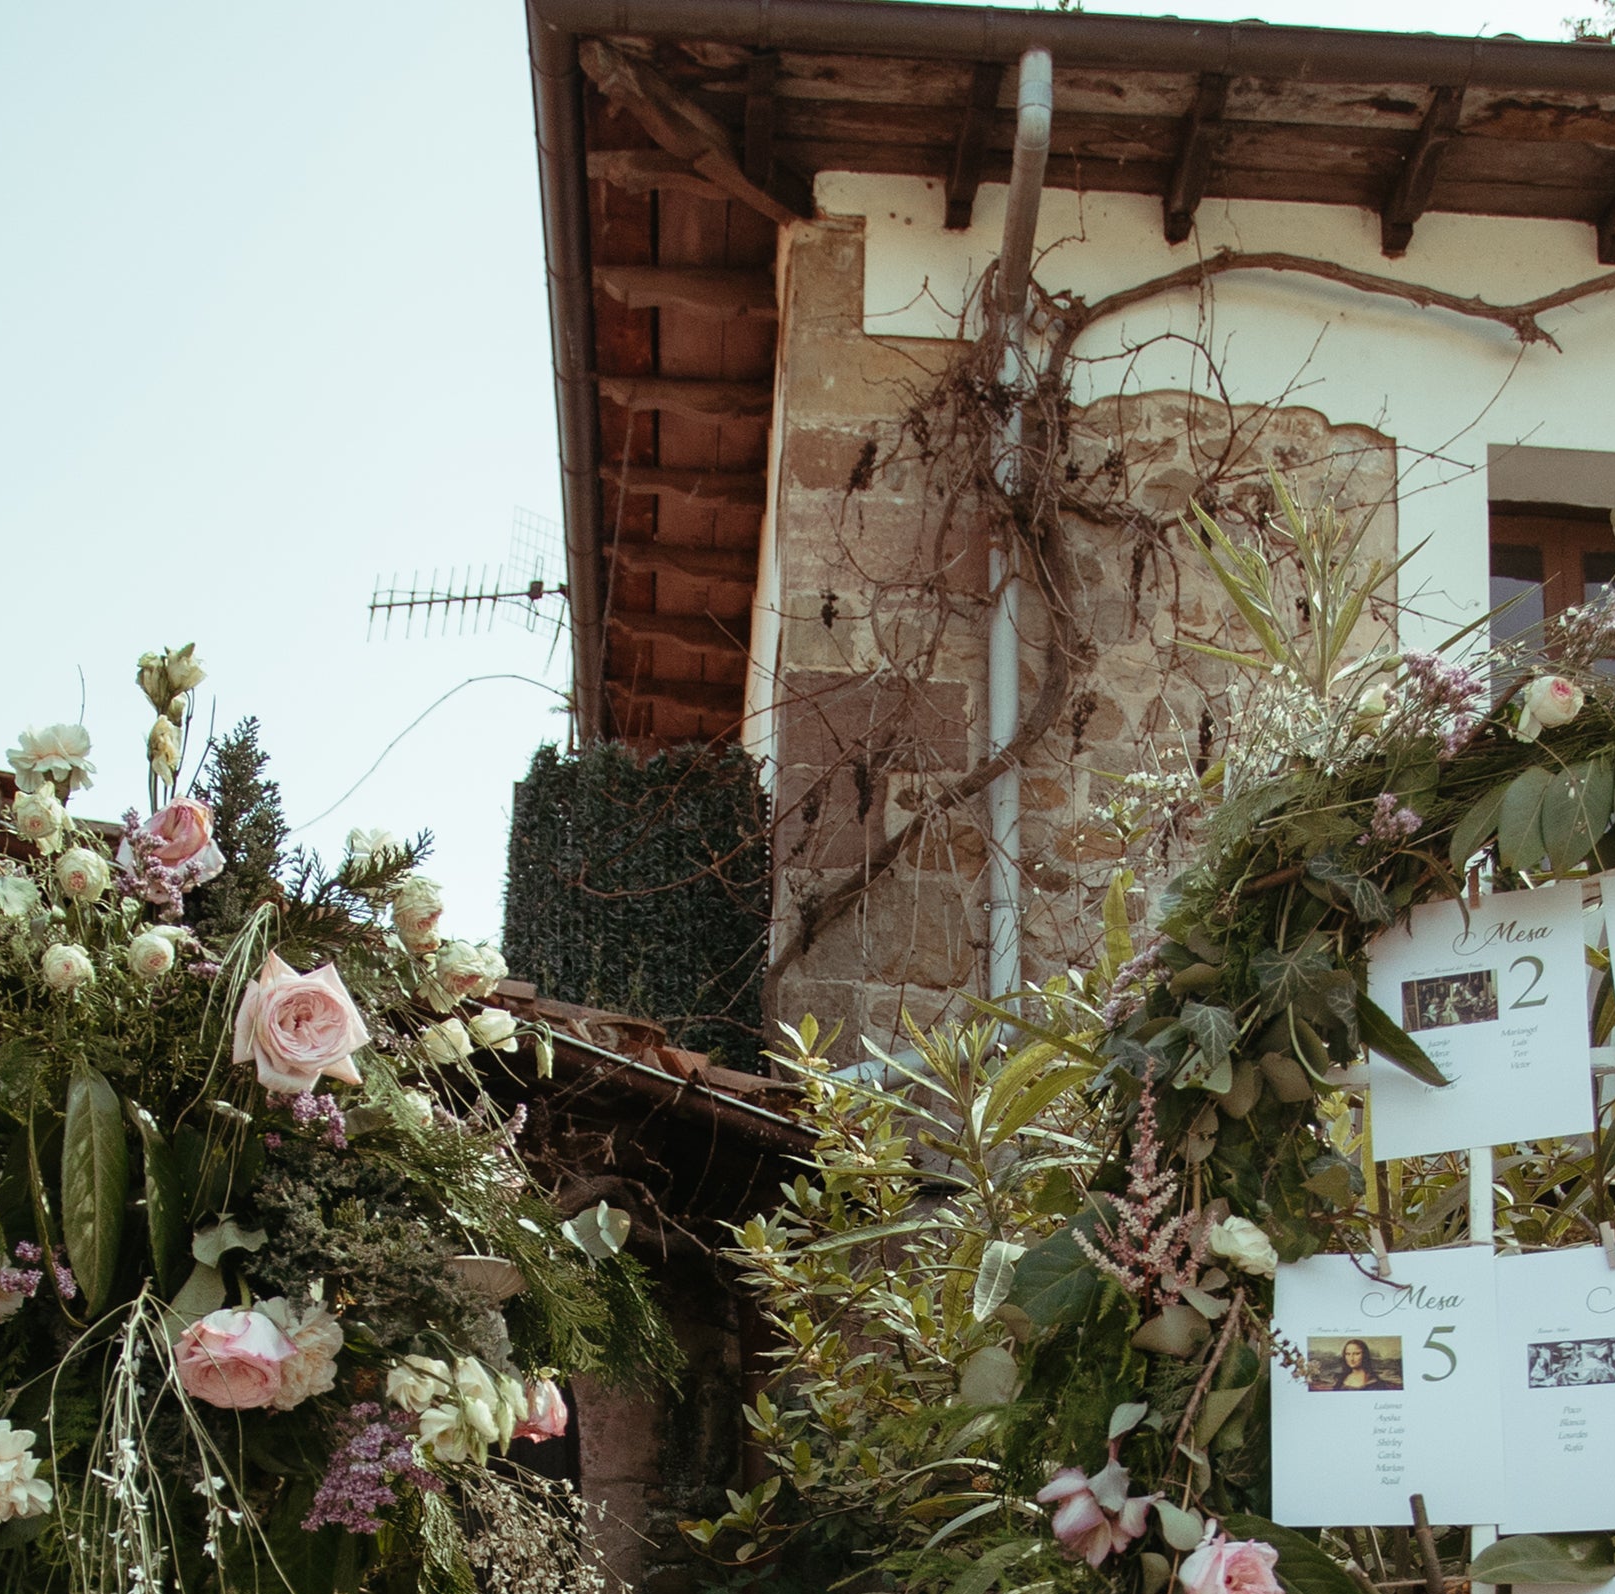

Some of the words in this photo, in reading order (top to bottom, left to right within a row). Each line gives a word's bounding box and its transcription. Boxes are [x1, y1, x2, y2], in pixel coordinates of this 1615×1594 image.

[1453, 920, 1554, 956] Mesa
[1509, 955, 1549, 1010] 2
[1361, 1285, 1465, 1318] Mesa
[1422, 1326, 1457, 1382] 5
[1558, 1431, 1589, 1439] Lourdes
